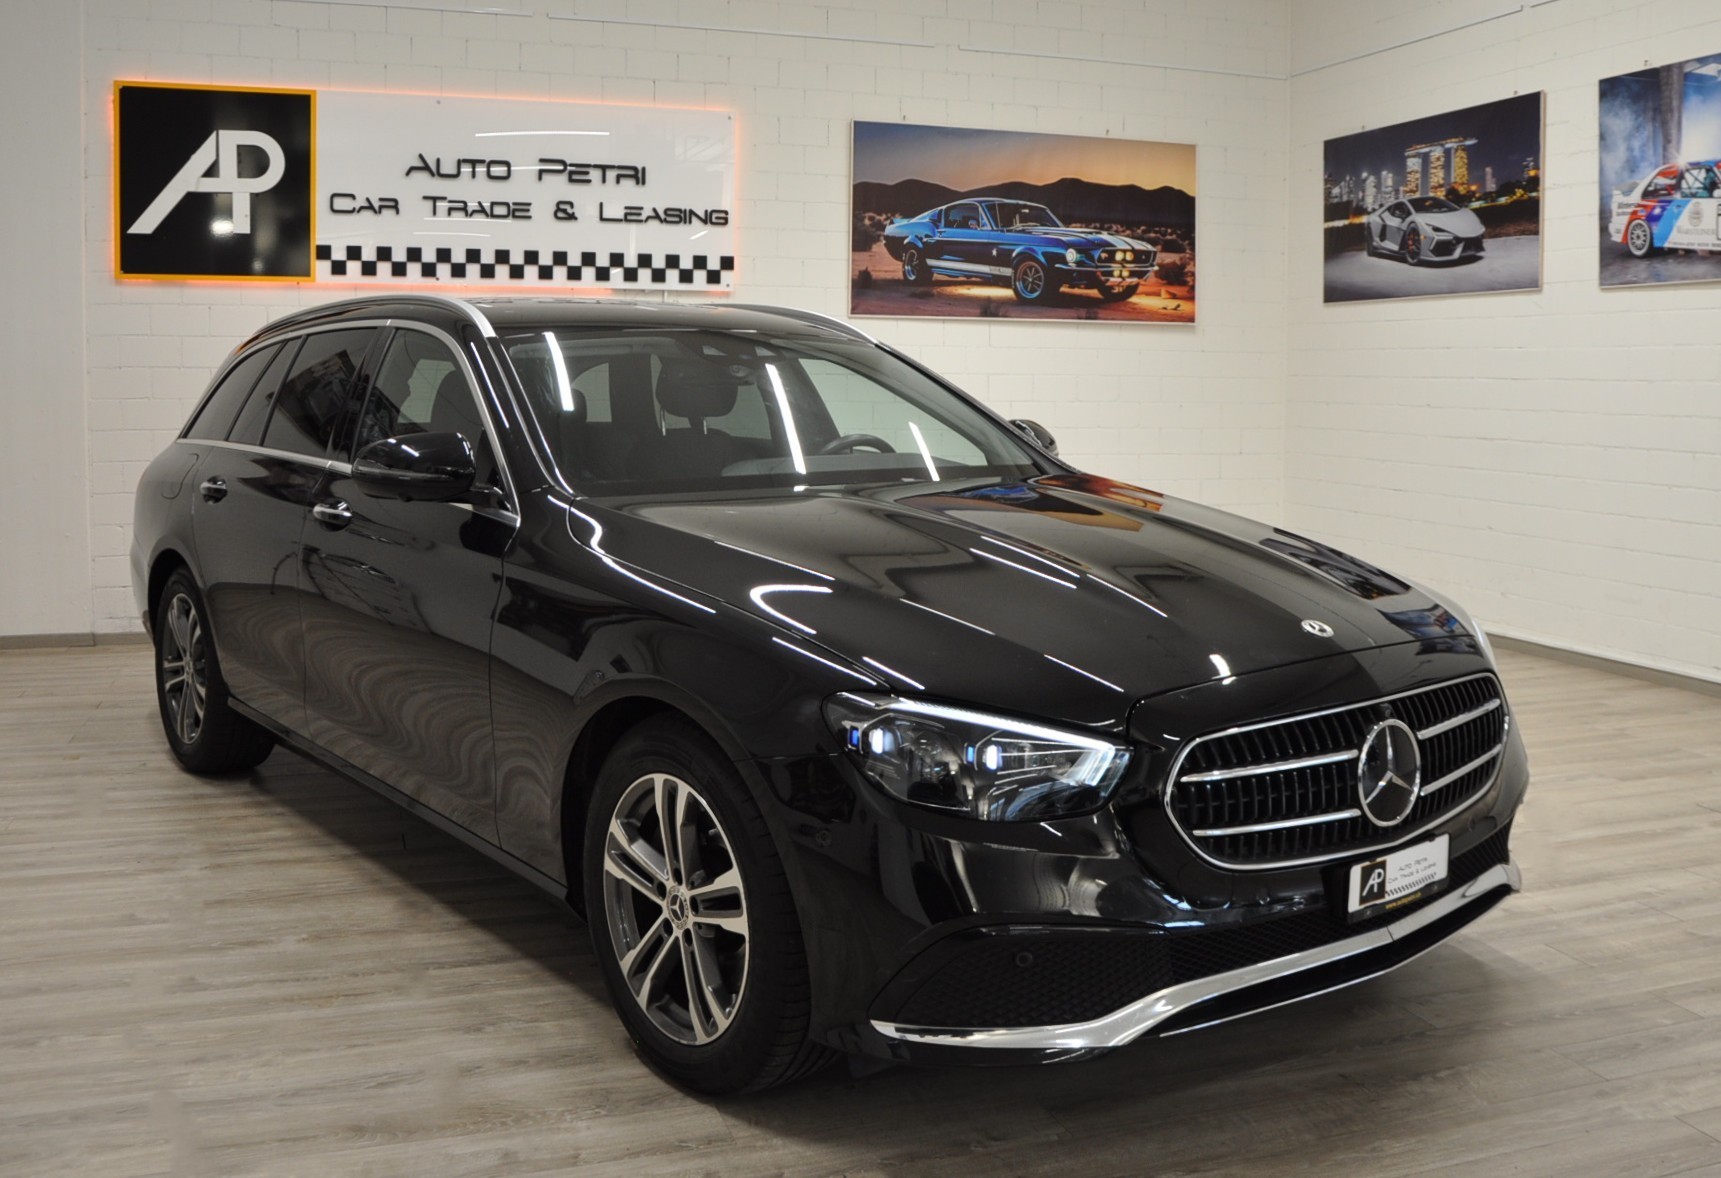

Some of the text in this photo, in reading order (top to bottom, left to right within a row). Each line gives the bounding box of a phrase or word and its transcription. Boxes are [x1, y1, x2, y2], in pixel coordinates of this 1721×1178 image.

[405, 153, 647, 186] AUTO PETRI
[329, 192, 729, 226] CAR TRADE & LEASING
